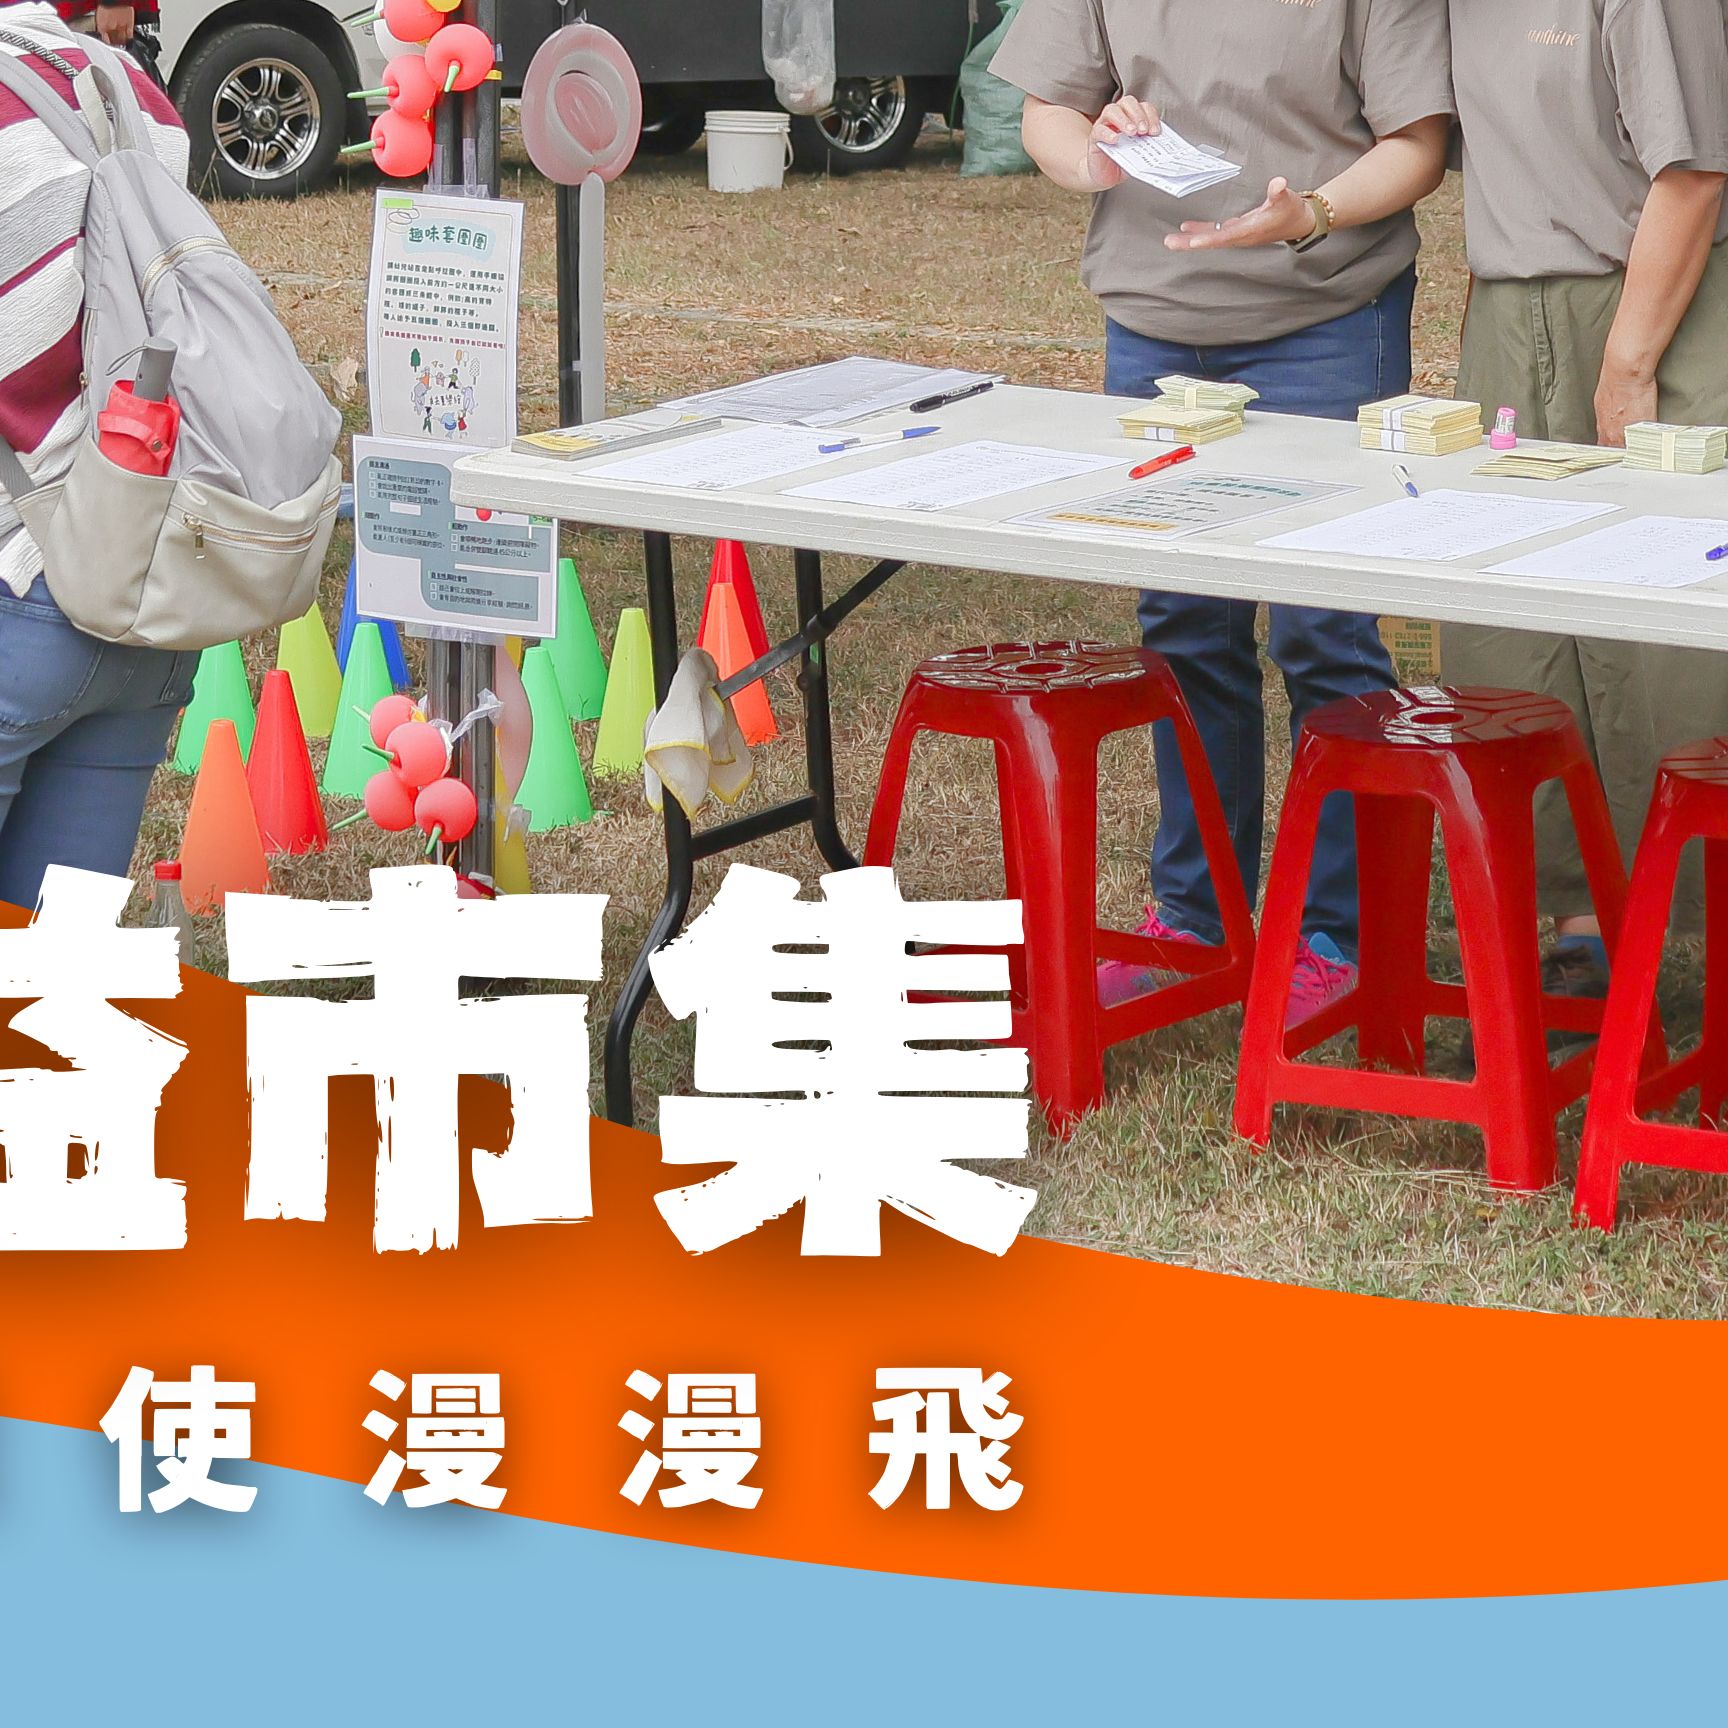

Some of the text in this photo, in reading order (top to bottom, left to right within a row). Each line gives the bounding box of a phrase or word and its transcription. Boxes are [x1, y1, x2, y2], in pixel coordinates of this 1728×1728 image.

[409, 225, 487, 250] 趣味套圈圈
